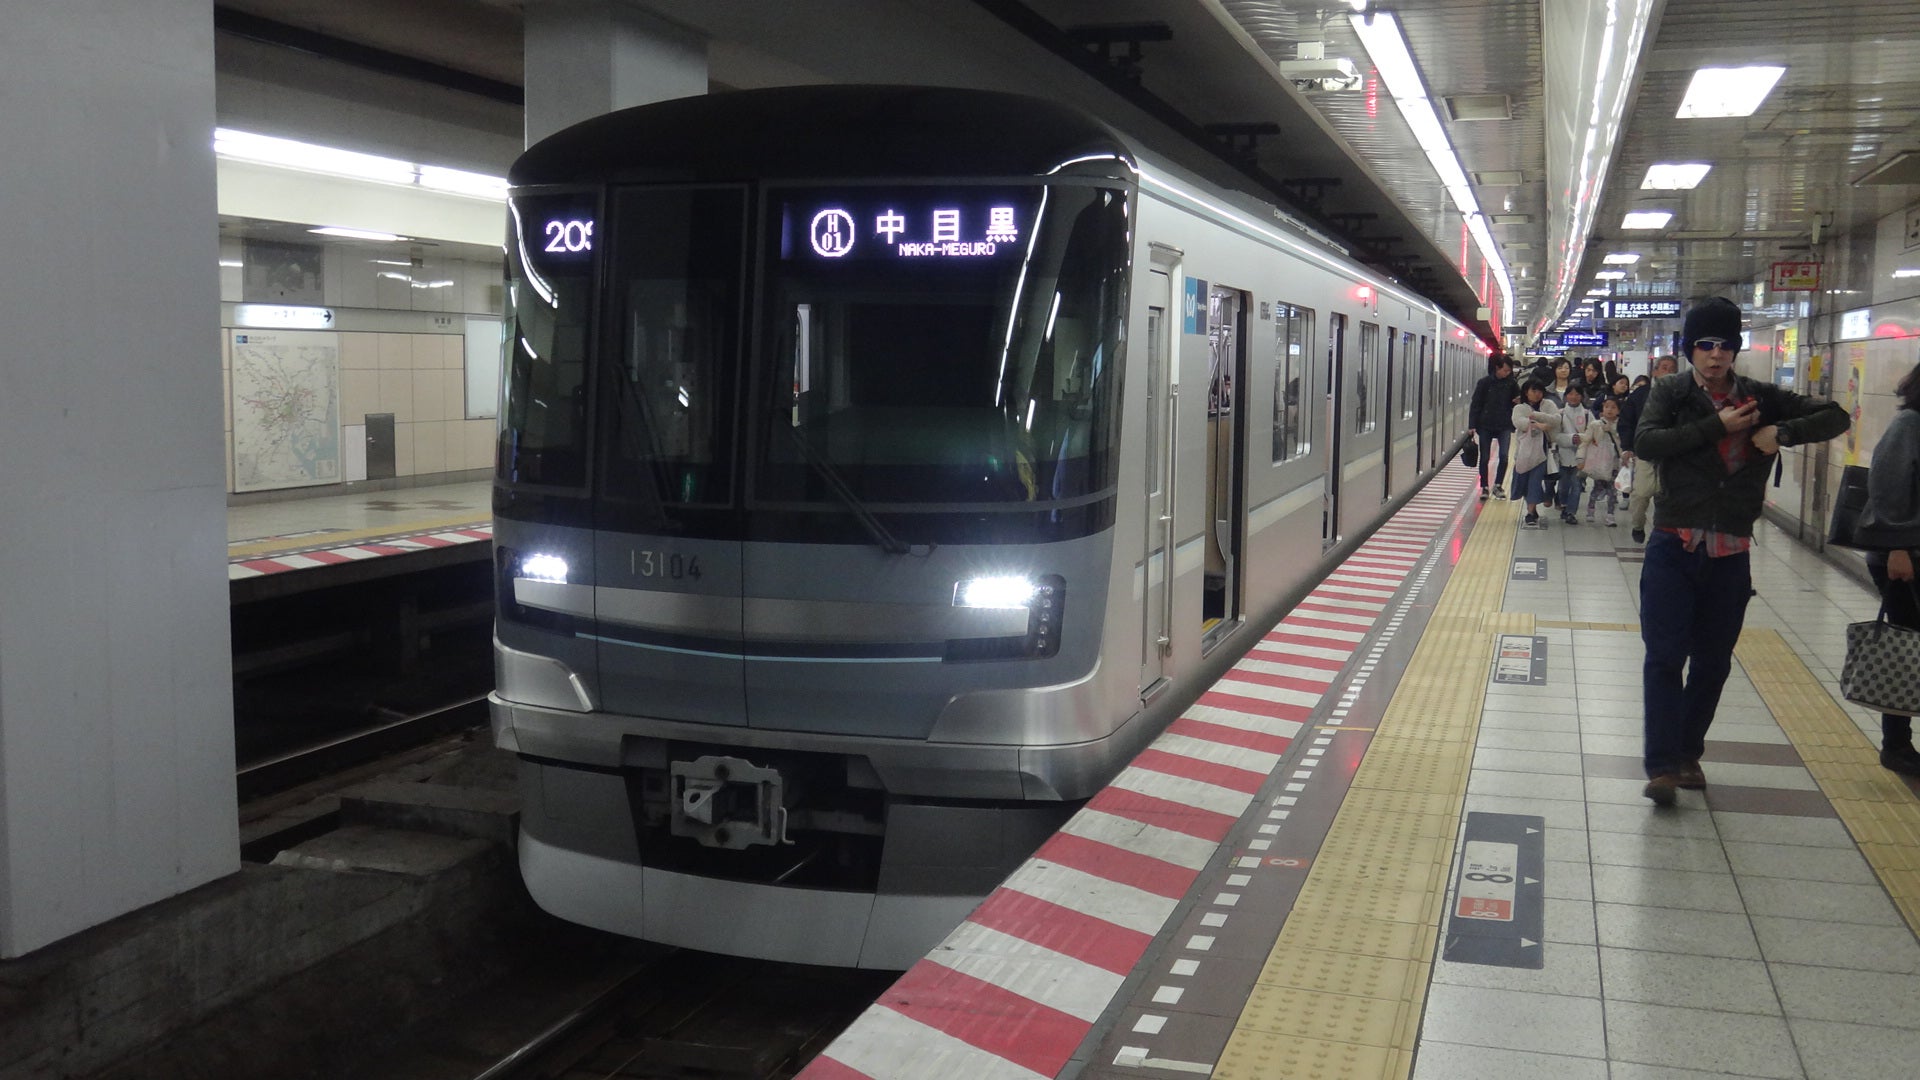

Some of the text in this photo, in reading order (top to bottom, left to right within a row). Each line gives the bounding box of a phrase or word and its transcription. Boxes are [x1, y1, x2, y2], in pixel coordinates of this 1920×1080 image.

[827, 214, 839, 233] H
[876, 208, 1018, 244] 中目黒
[821, 232, 843, 251] 01
[899, 242, 996, 256] NAKA-MEGURO
[1600, 301, 1609, 318] 1
[631, 549, 701, 580] 13104
[1465, 872, 1514, 884] 8
